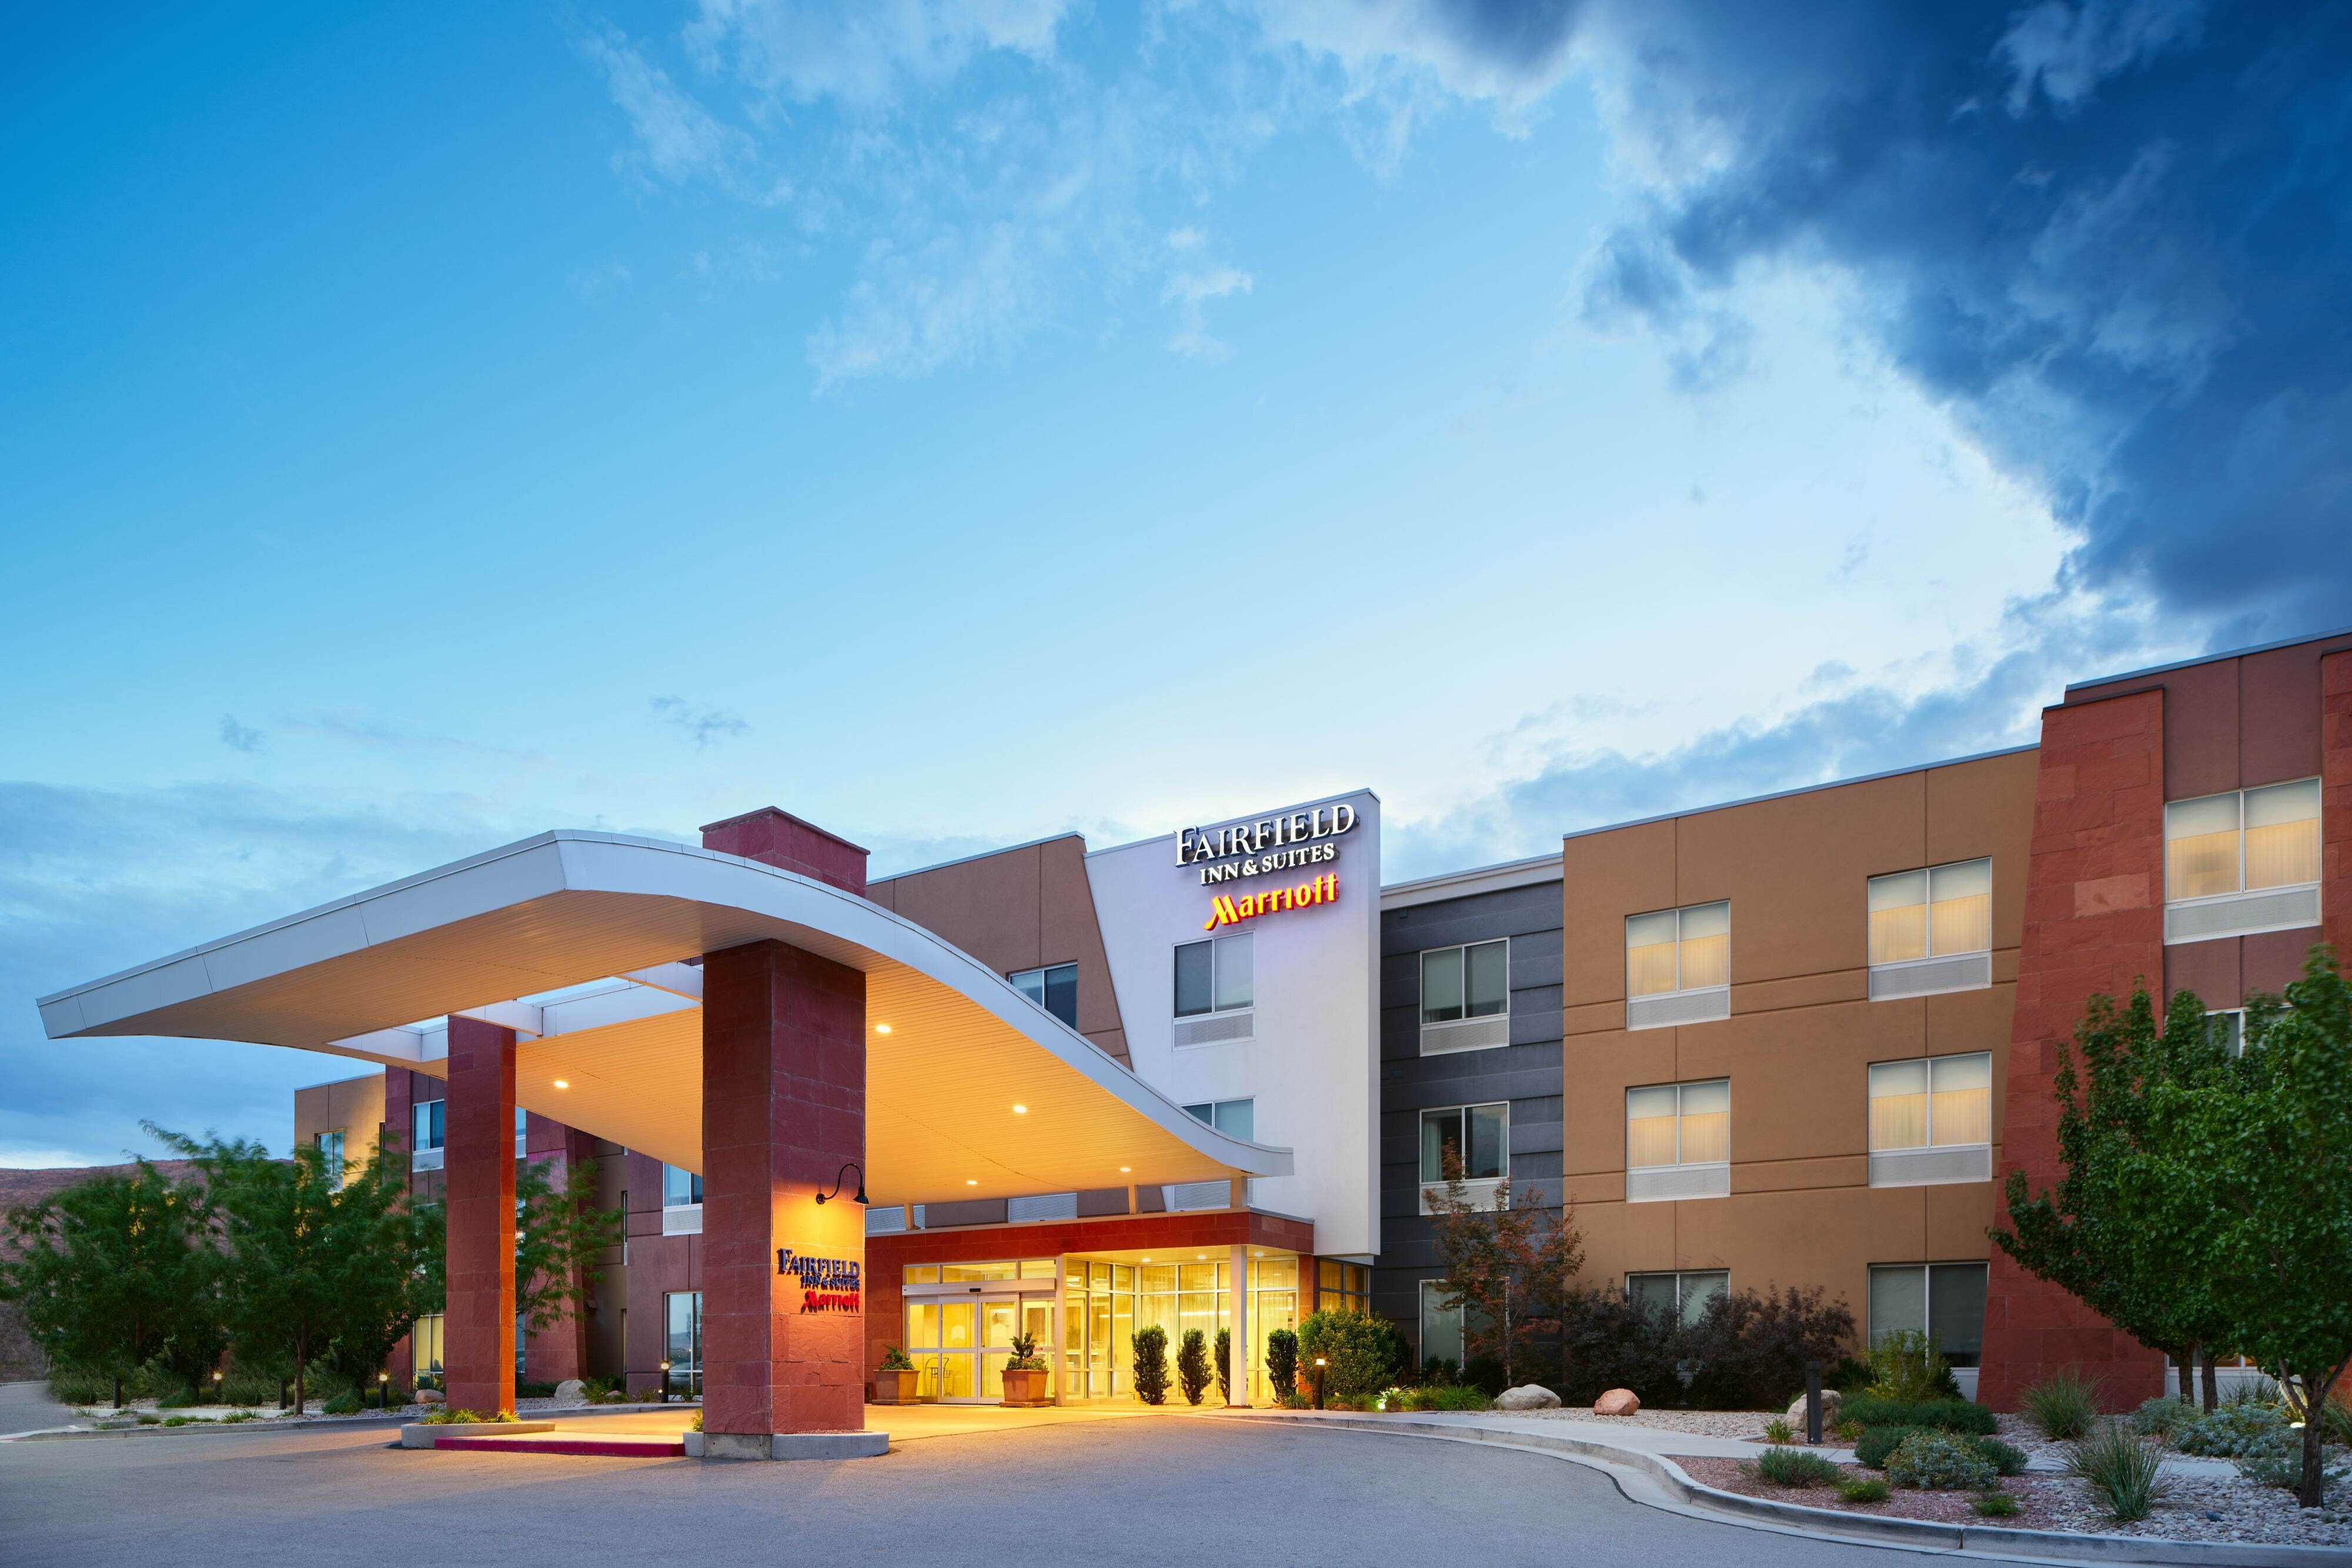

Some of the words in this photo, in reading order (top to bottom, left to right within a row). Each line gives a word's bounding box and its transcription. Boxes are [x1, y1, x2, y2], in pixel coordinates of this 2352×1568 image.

[1174, 803, 1357, 868] FAIRFIELD
[1200, 862, 1240, 885] INN
[1242, 859, 1259, 876] &
[1262, 842, 1337, 872] SUITES
[1204, 873, 1338, 931] Marriott
[779, 1248, 860, 1276] FAIRFIELD
[802, 1275, 821, 1285] INN
[830, 1278, 860, 1288] SUITES
[803, 1290, 860, 1308] Marriott
